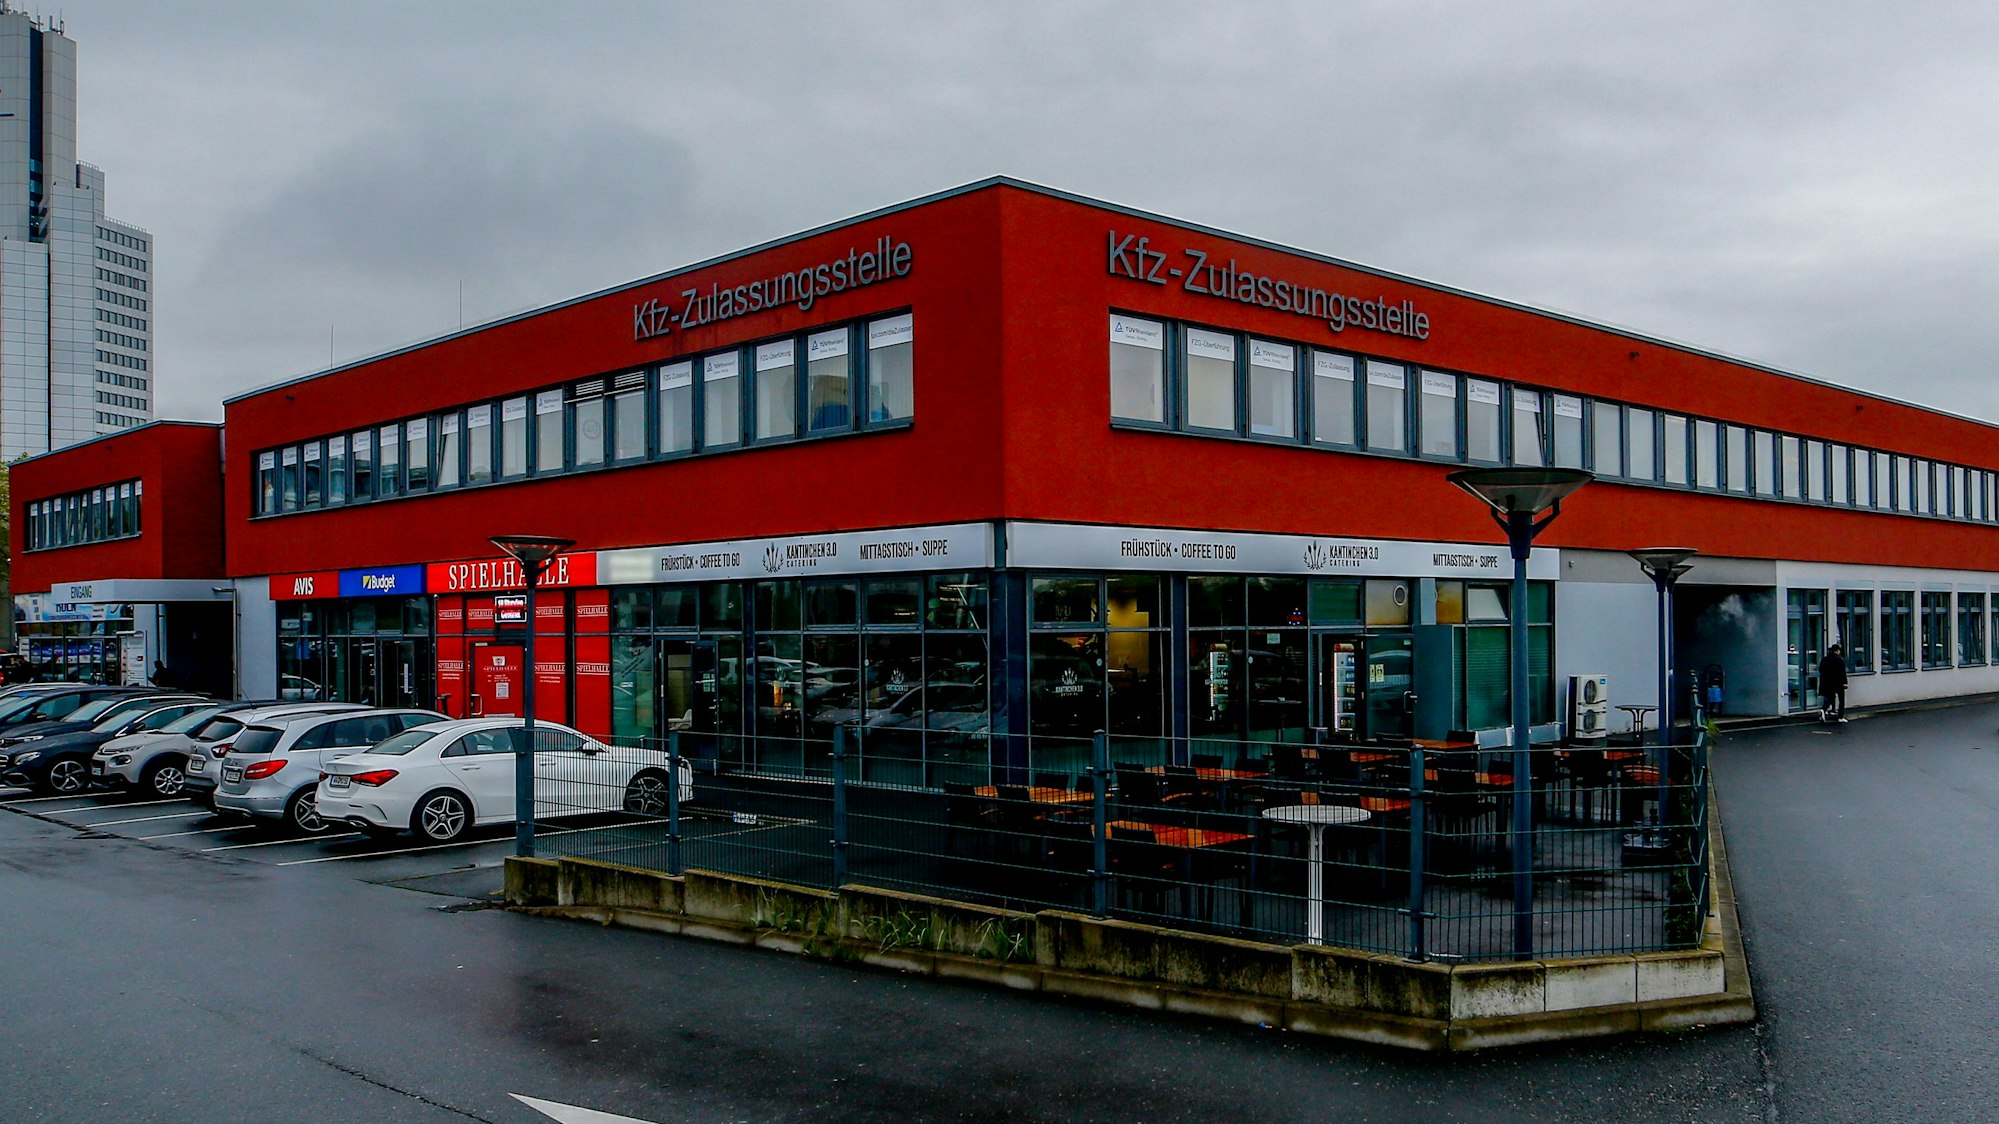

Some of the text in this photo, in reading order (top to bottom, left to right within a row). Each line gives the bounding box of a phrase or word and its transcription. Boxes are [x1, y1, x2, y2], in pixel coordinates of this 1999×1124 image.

[634, 235, 912, 340] Kfz-Zulassungsstelle
[1109, 230, 1431, 340] Kfz-Zulassungsstelle
[826, 542, 837, 557] 3.0
[860, 539, 947, 560] MITTAGSTISCH SUPPE
[1121, 538, 1236, 560] FRÜHSTÜCK COFFEE TO GO
[1368, 546, 1379, 560] 3.0
[661, 552, 740, 571] FRÜHSTÜCK COFFEE TO GO
[1433, 553, 1498, 568] MITTAGSTISCH SUPPE
[293, 577, 313, 595] AVIS
[371, 574, 396, 593] Budget
[70, 585, 92, 599] EINGANG
[577, 606, 608, 614] SPIELHALLE
[438, 662, 464, 670] SPIELHALLE
[534, 664, 566, 672] SPIELHALLE
[576, 664, 610, 673] SPIELHALLE
